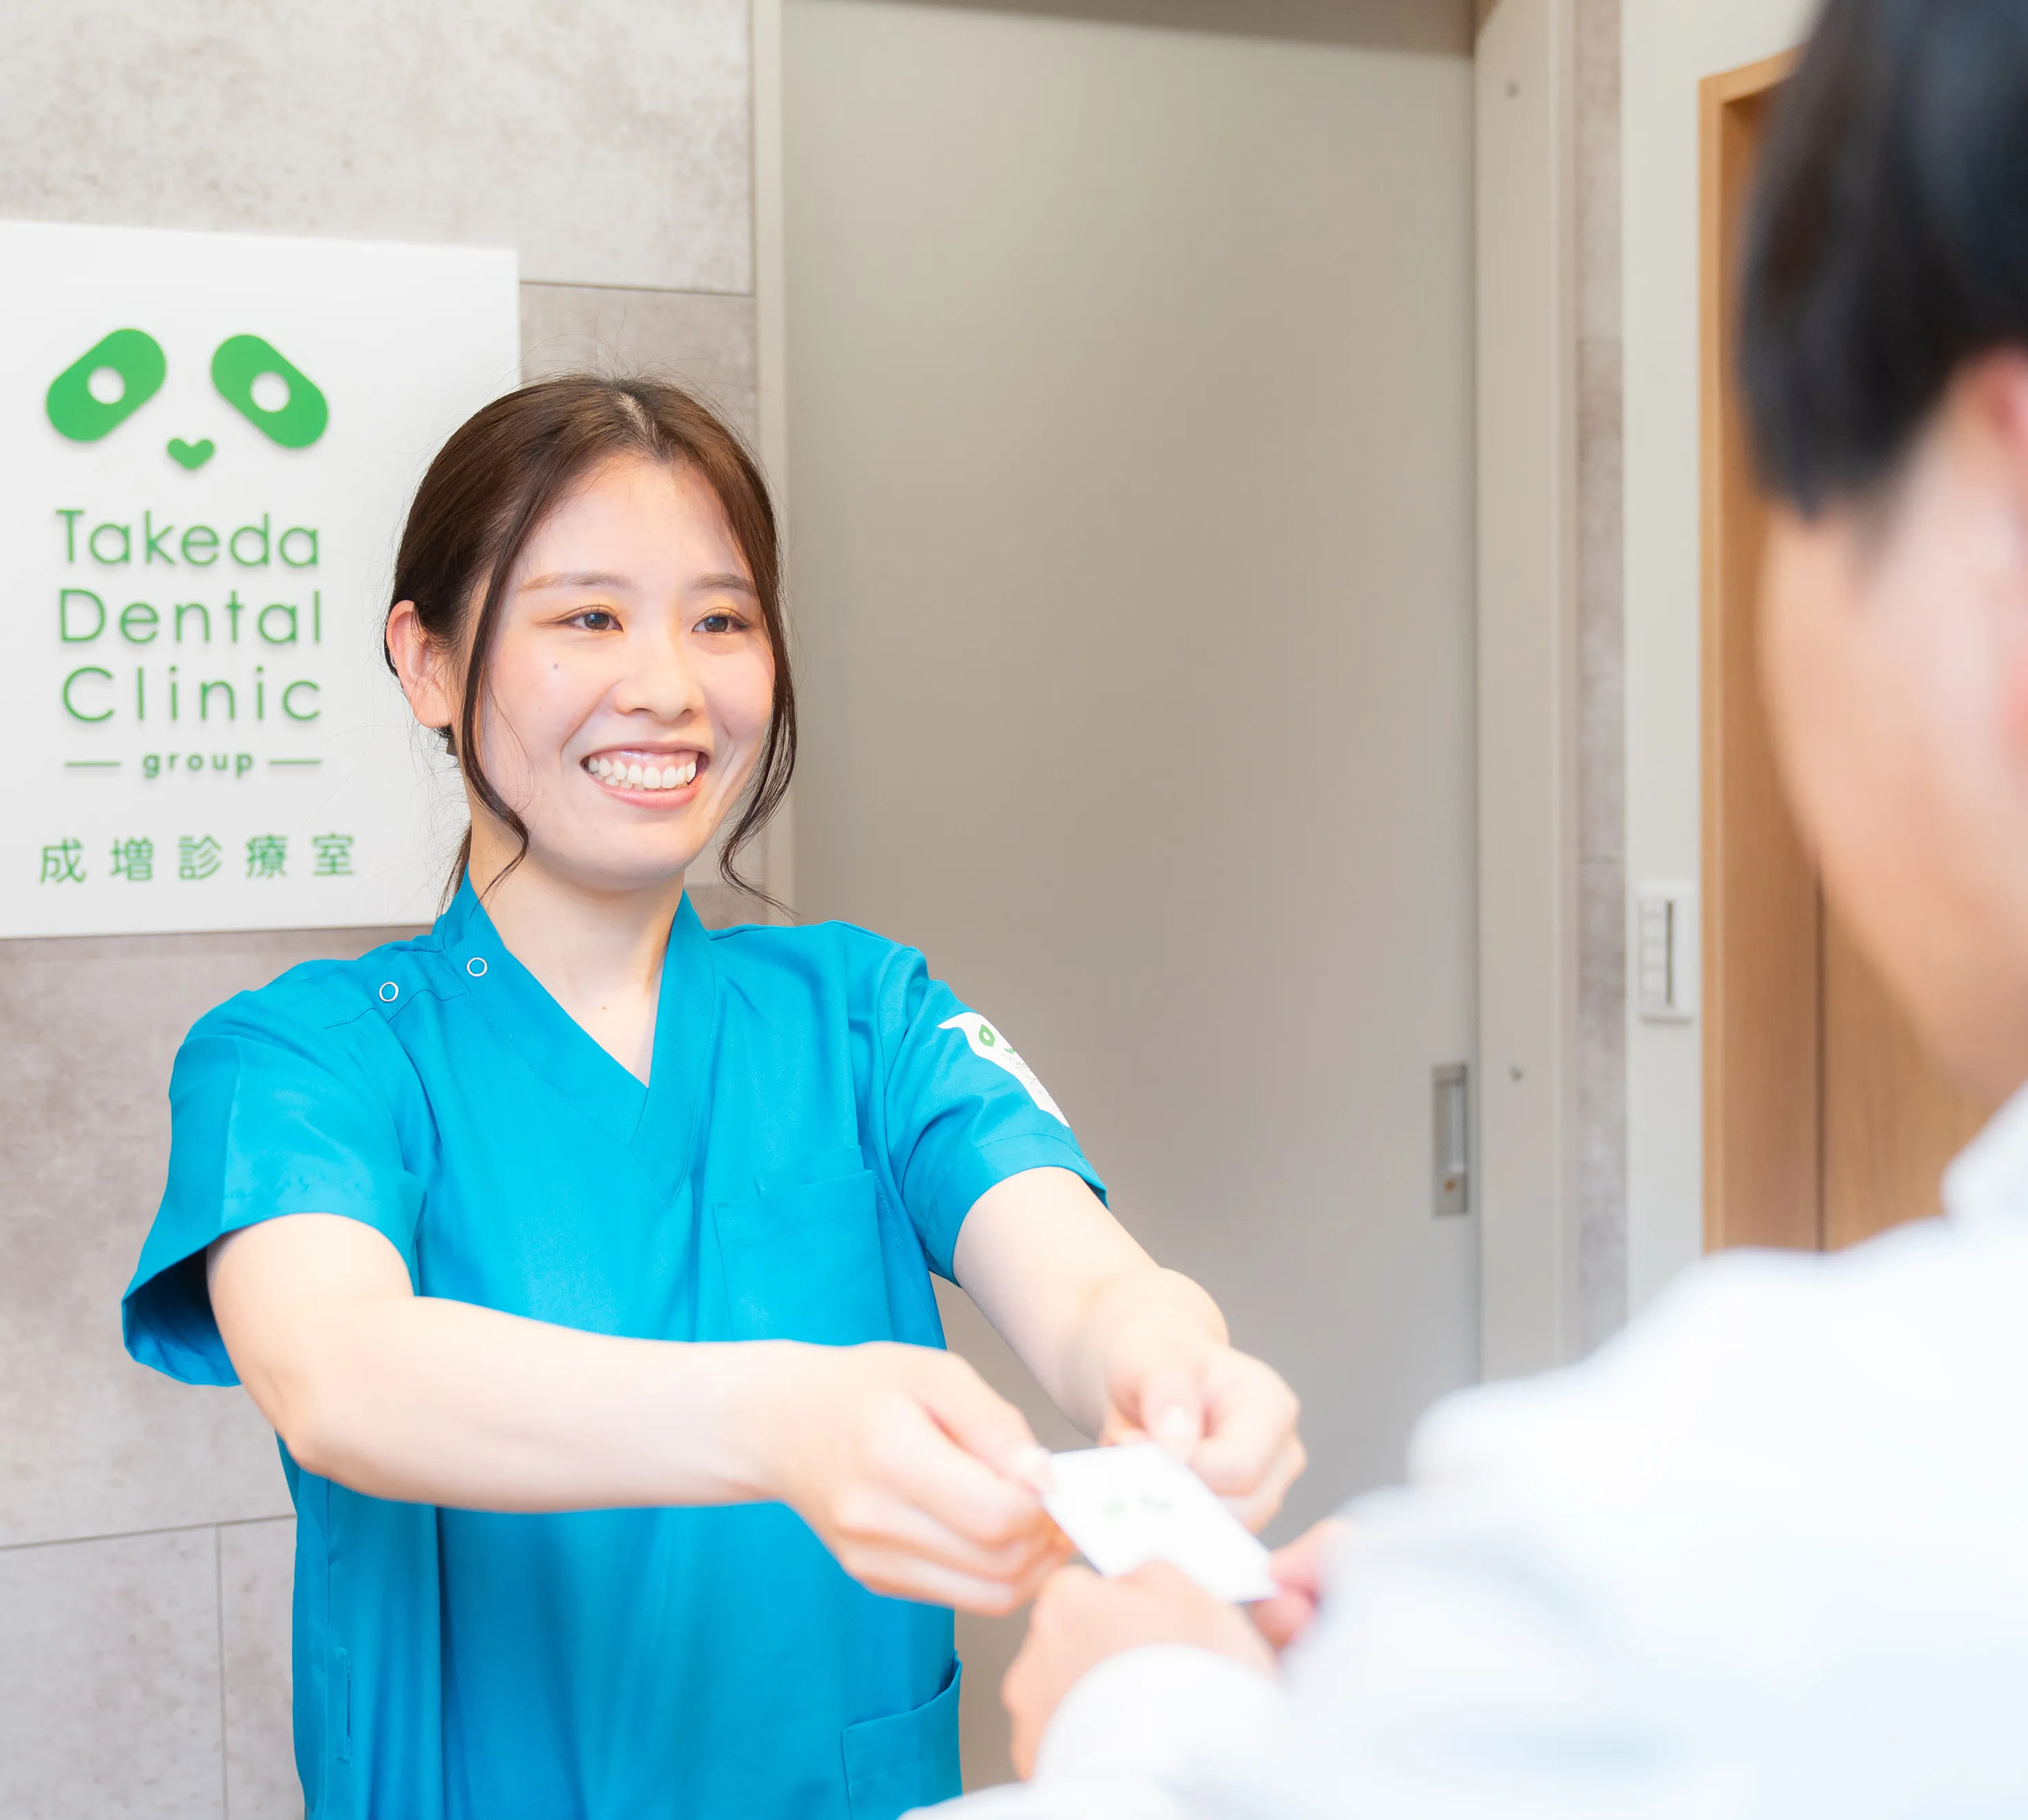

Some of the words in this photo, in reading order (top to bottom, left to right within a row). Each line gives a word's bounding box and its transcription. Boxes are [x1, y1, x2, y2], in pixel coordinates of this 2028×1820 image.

[56, 509, 319, 568] Takeda
[59, 588, 321, 645] Dental
[62, 665, 321, 723] Clinic
[142, 753, 254, 778] group
[40, 833, 355, 884] 成増診療室
